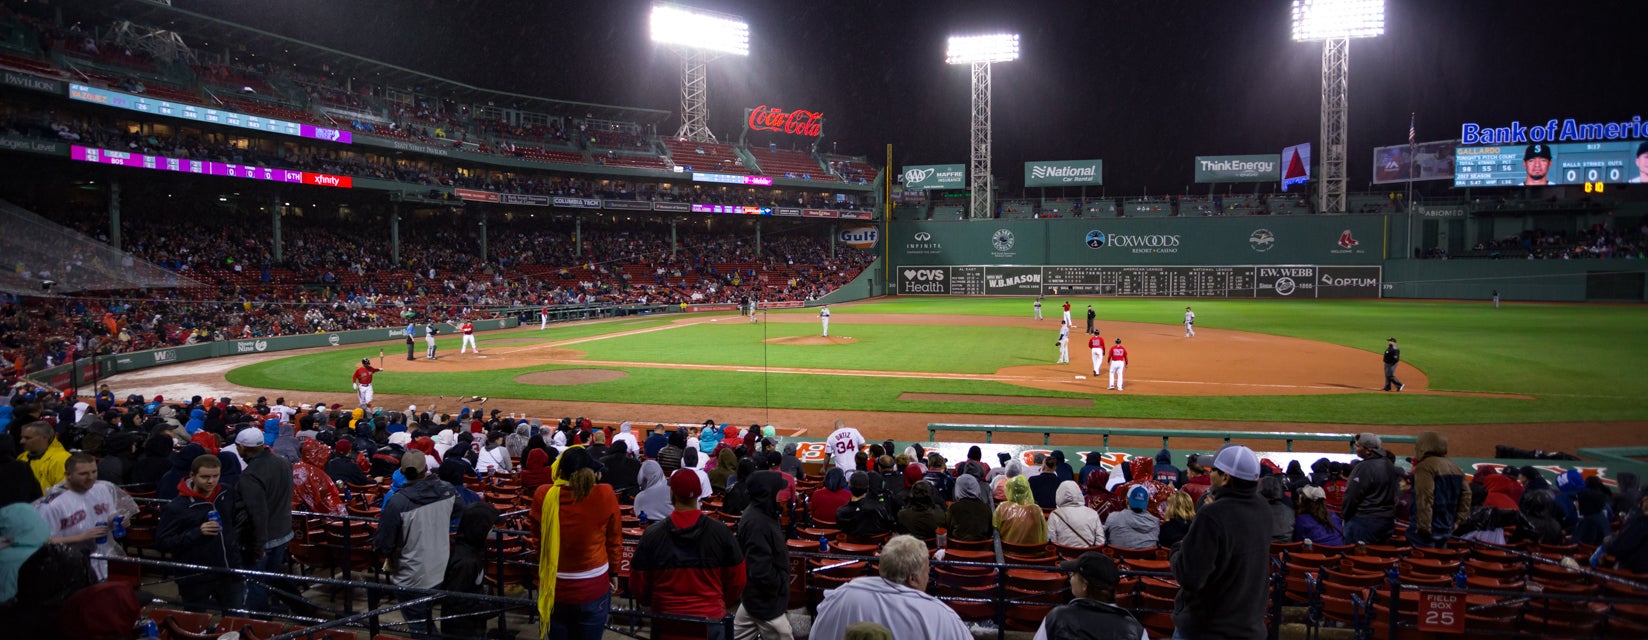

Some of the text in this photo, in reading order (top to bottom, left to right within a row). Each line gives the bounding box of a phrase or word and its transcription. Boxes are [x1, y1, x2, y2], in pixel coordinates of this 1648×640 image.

[5, 73, 54, 91] PAVILION
[748, 104, 824, 136] Coca-Cola
[1462, 120, 1527, 144] Bank
[1530, 119, 1558, 142] of
[1046, 165, 1096, 176] National
[1201, 160, 1273, 172] ThinkEnergy
[314, 175, 339, 186] xfinity
[907, 170, 924, 182] AAA
[1567, 169, 1619, 181] 0 0 0
[841, 231, 876, 242] Gulf
[1108, 234, 1180, 247] FOXWOODS
[917, 270, 944, 280] CVS
[905, 282, 944, 292] Health
[1334, 278, 1376, 286] OPTUM
[835, 432, 851, 440] ORTIZ
[836, 439, 855, 454] 34
[621, 560, 630, 570] 2
[1426, 611, 1455, 625] 25
